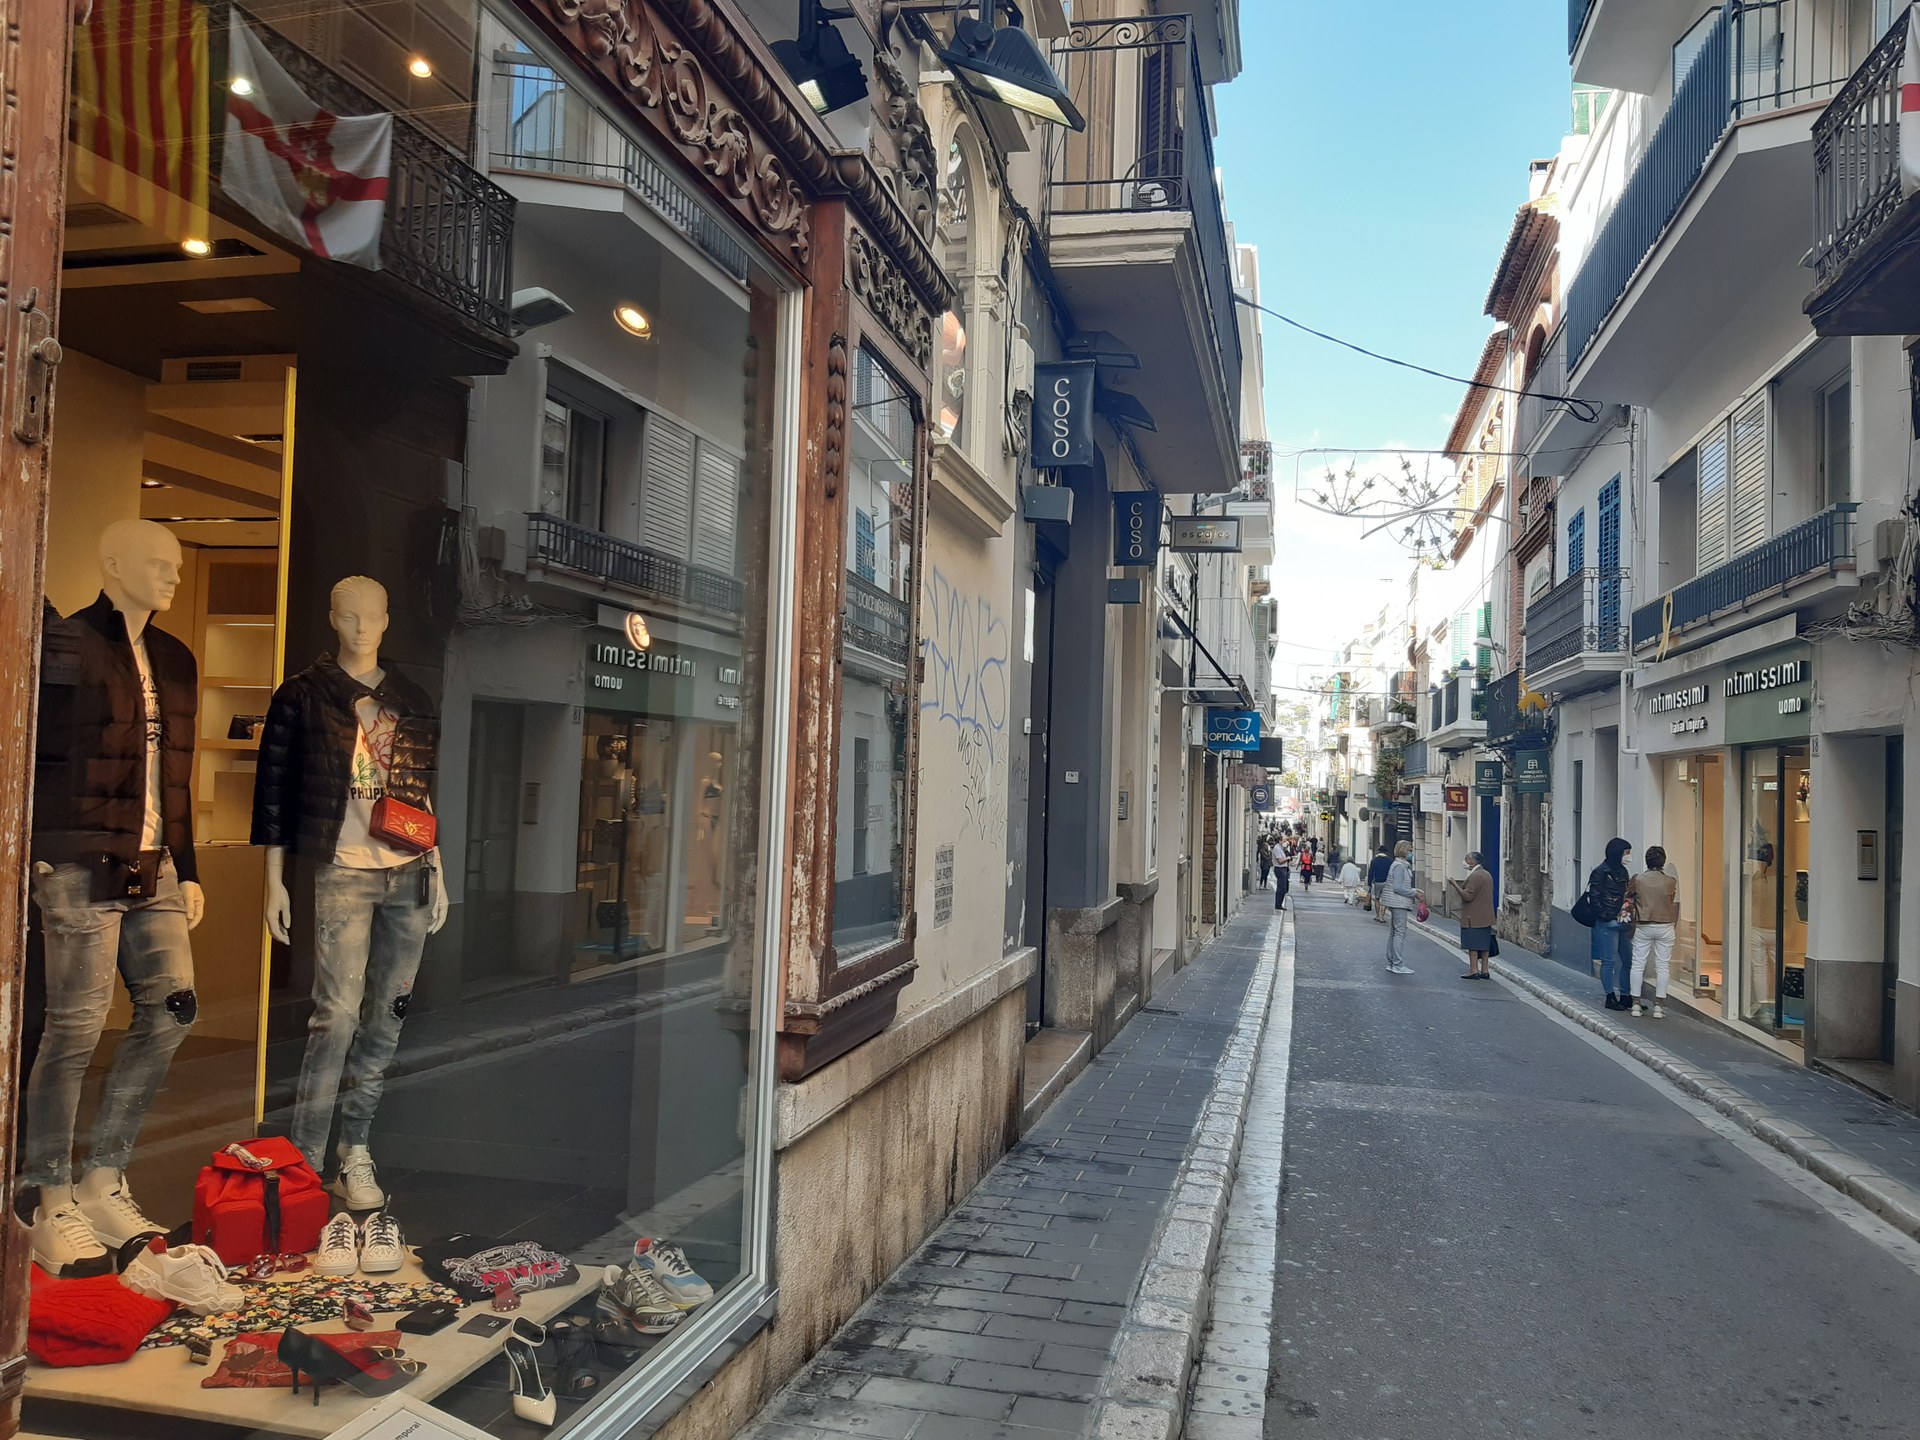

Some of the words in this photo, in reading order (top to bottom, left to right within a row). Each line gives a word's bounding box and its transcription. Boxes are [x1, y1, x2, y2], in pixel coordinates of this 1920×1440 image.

[1052, 378, 1070, 458] COSO
[1130, 502, 1142, 558] COSO
[1181, 529, 1232, 539] escales
[1778, 697, 1801, 715] uomo
